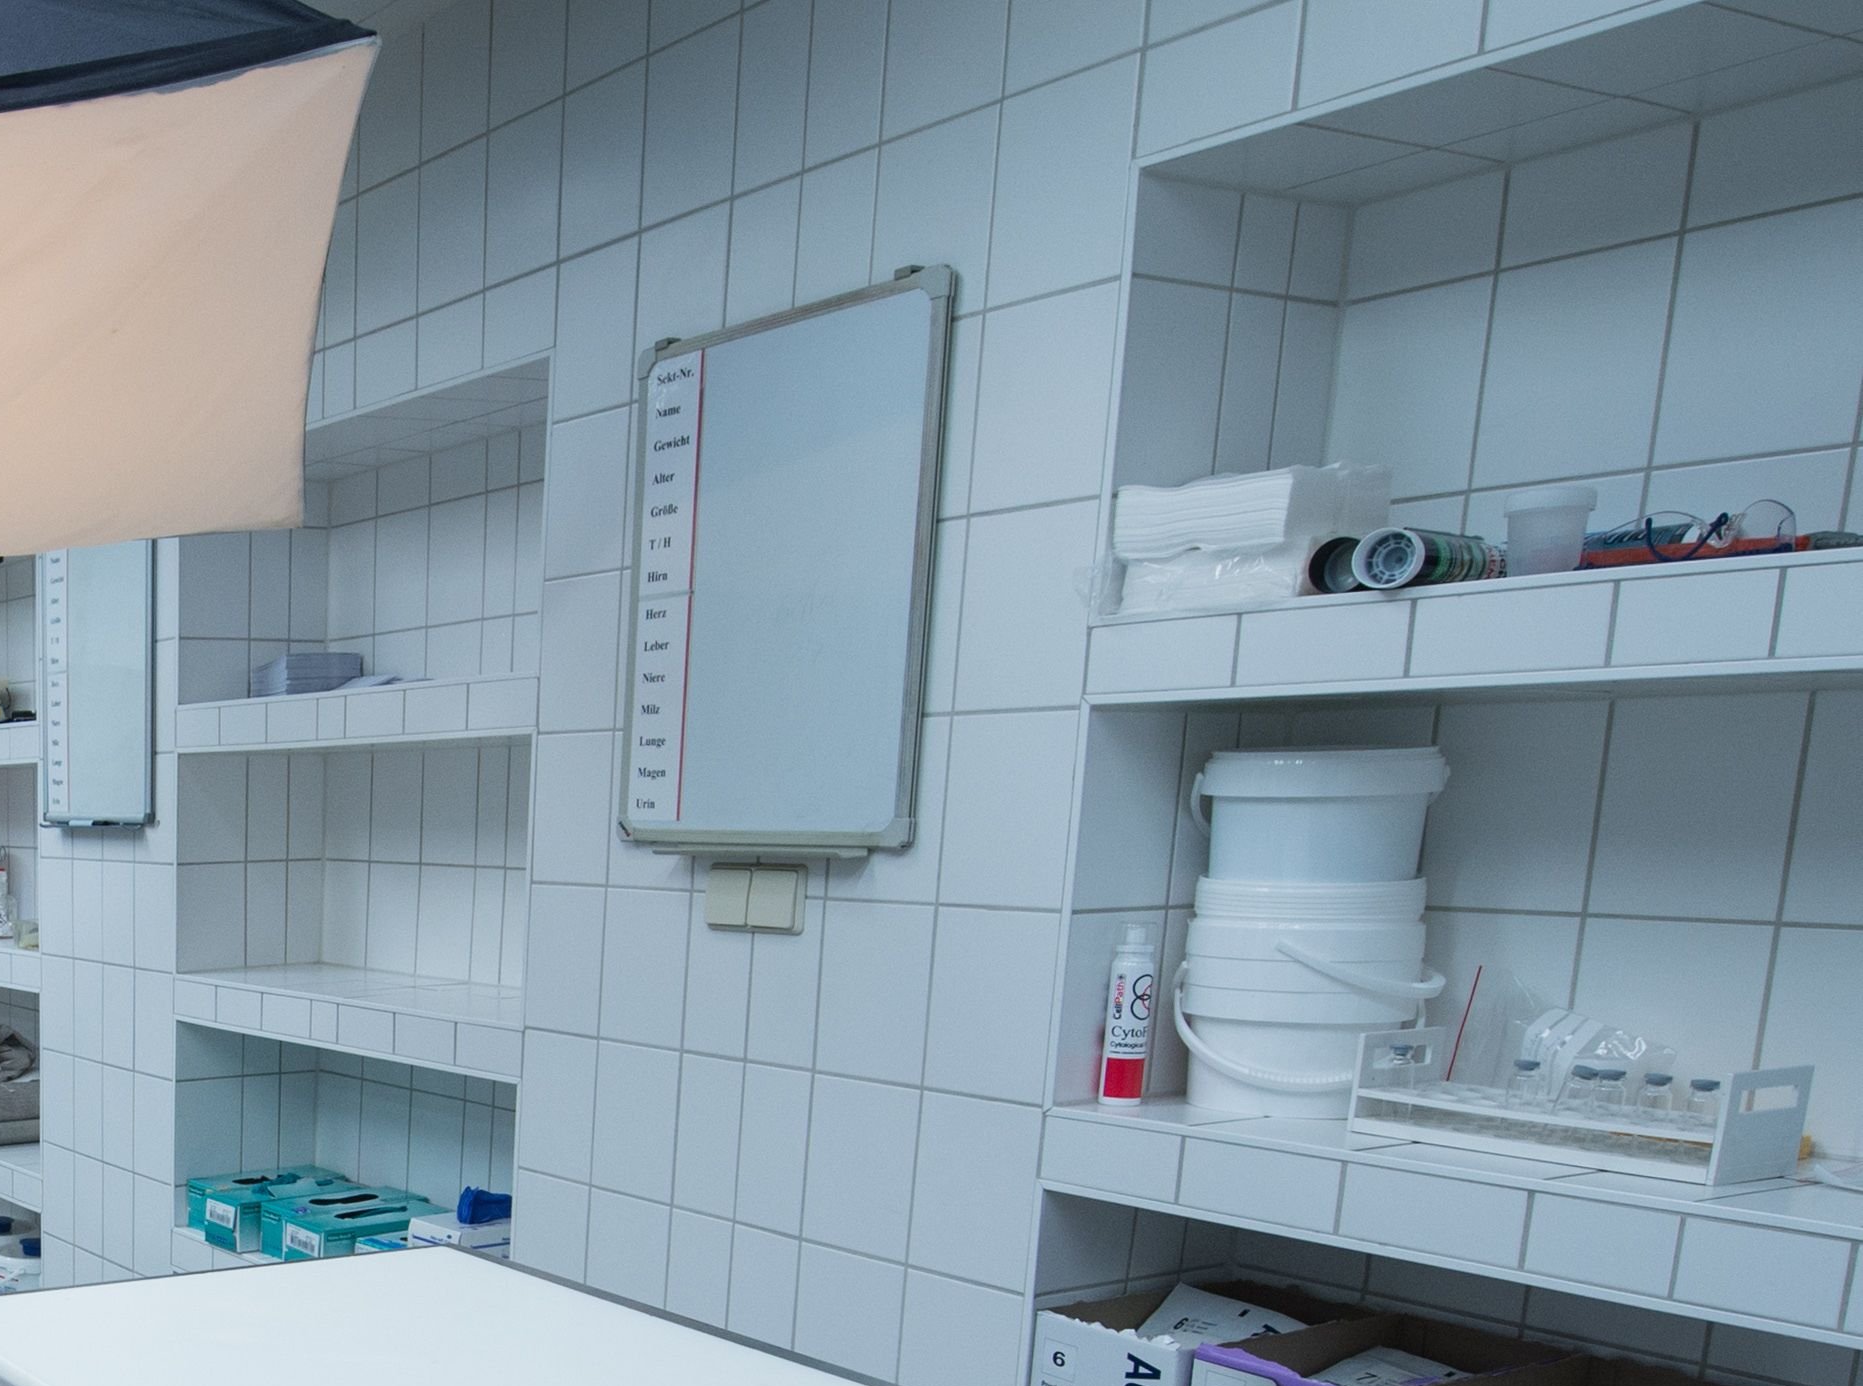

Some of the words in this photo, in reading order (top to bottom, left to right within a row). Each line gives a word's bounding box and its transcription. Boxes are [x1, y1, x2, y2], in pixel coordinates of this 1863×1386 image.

[657, 367, 694, 386] Sekt-Nr.
[656, 404, 680, 419] Name
[654, 434, 690, 452] Gewicht
[652, 471, 675, 485] Alter
[651, 502, 678, 518] Größe
[648, 539, 657, 550] T
[663, 536, 672, 548] H
[647, 571, 668, 583] Hirn
[645, 608, 667, 621] Herz
[644, 641, 669, 652] Leber
[642, 672, 665, 684] Niere
[641, 704, 660, 716] Milz
[639, 735, 666, 749] Lunge
[638, 766, 666, 780] Magen
[636, 798, 655, 810] Urin
[1052, 1351, 1066, 1368] 6
